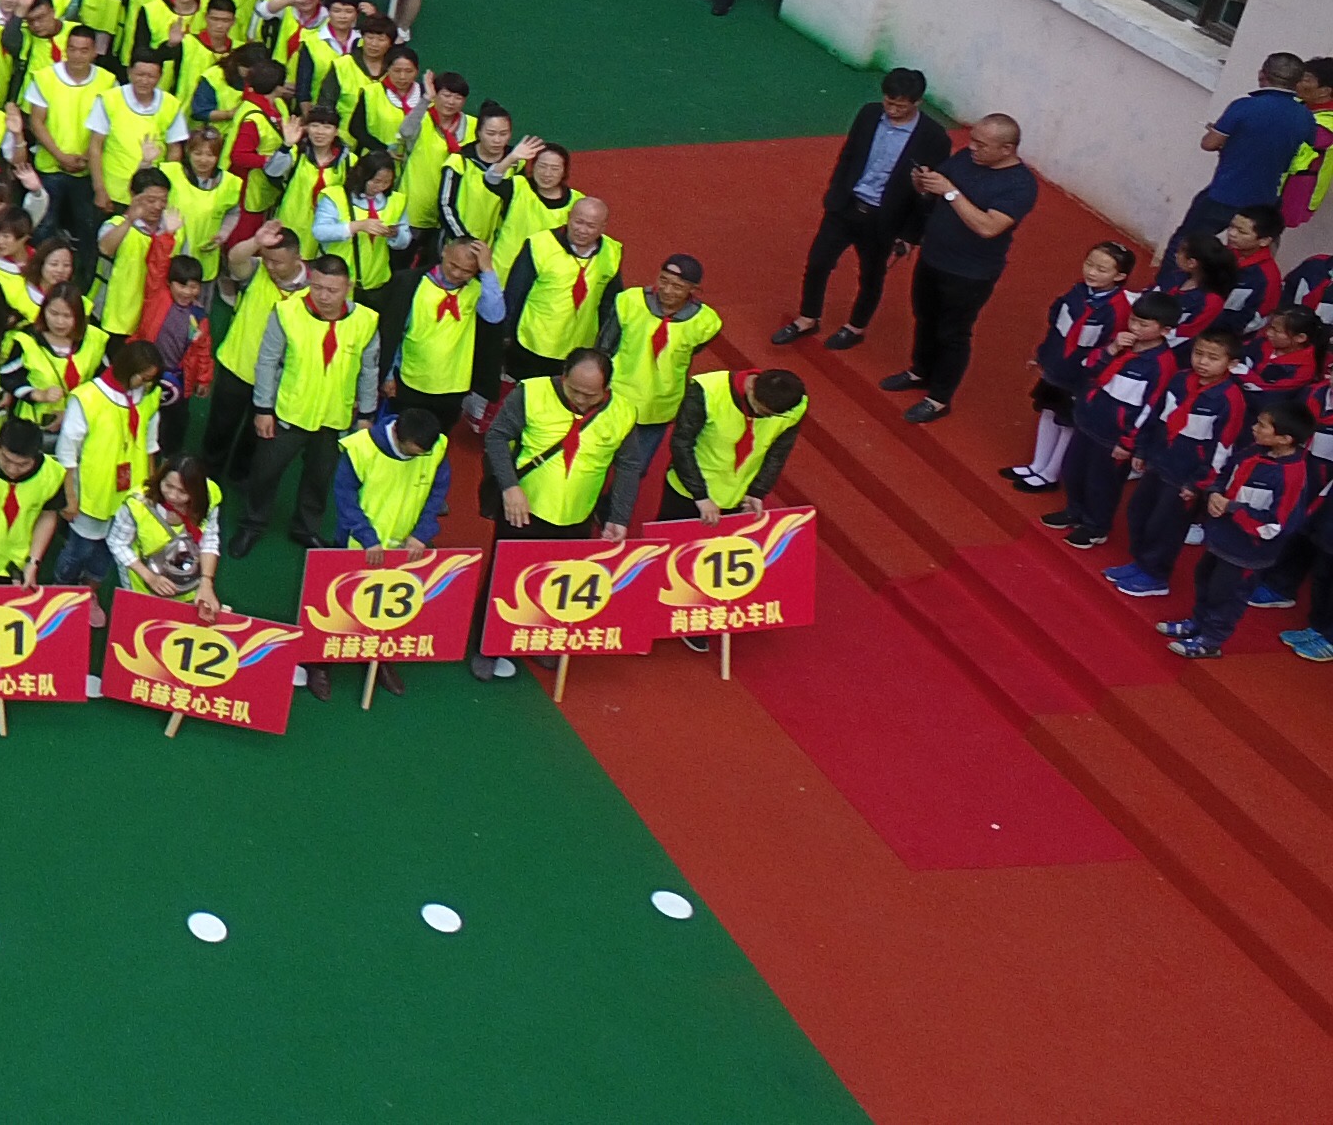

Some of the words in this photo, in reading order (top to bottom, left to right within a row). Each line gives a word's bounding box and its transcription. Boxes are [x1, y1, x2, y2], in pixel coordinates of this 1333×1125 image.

[704, 549, 754, 587] 15
[364, 582, 415, 618] 13
[551, 575, 602, 610] 14
[670, 599, 784, 634] 尚赫爱心车队
[323, 633, 435, 660] 尚赫爱心车队
[511, 627, 623, 653] 尚赫爱心车队
[173, 637, 229, 679] 12
[130, 677, 251, 725] 尚赫爱心车队
